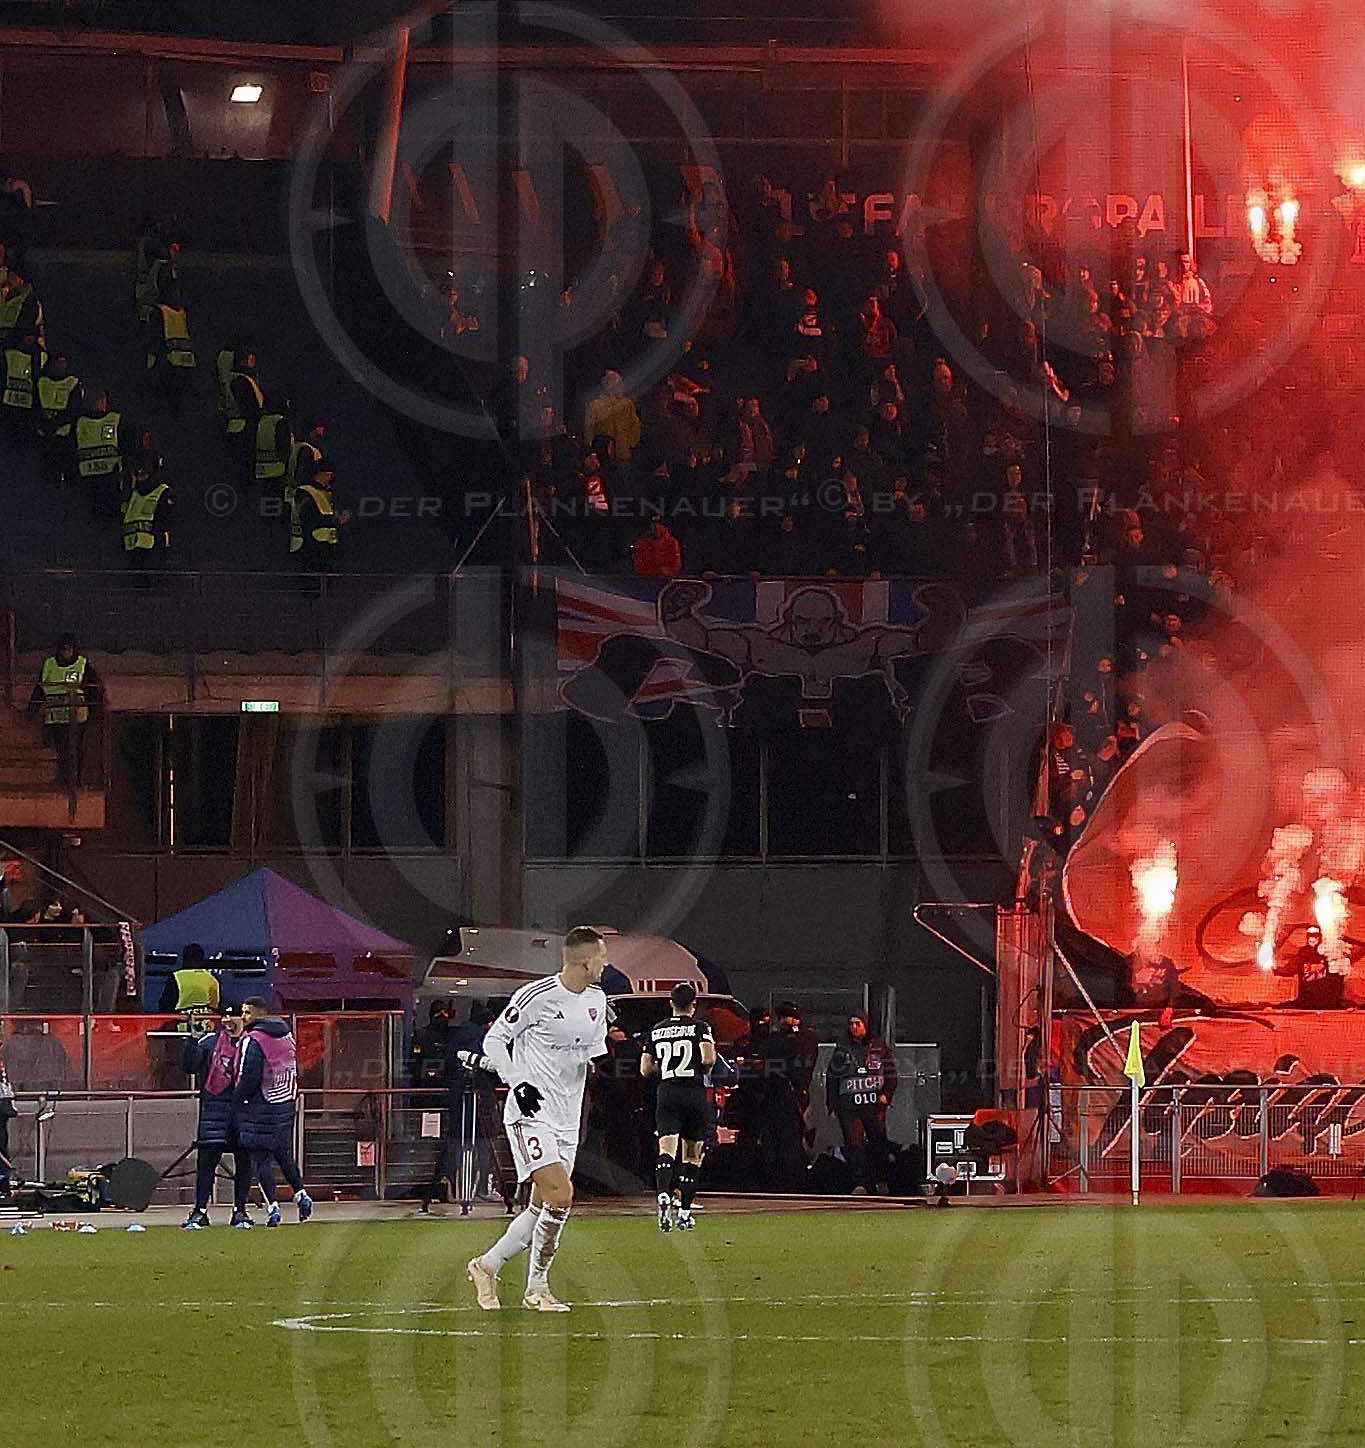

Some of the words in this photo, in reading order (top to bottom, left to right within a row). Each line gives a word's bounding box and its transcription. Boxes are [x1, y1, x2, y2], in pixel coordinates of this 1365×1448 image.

[655, 1039, 695, 1080] 22
[846, 1075, 885, 1091] PITCH
[854, 1092, 878, 1105] 010
[527, 1136, 544, 1161] 3
